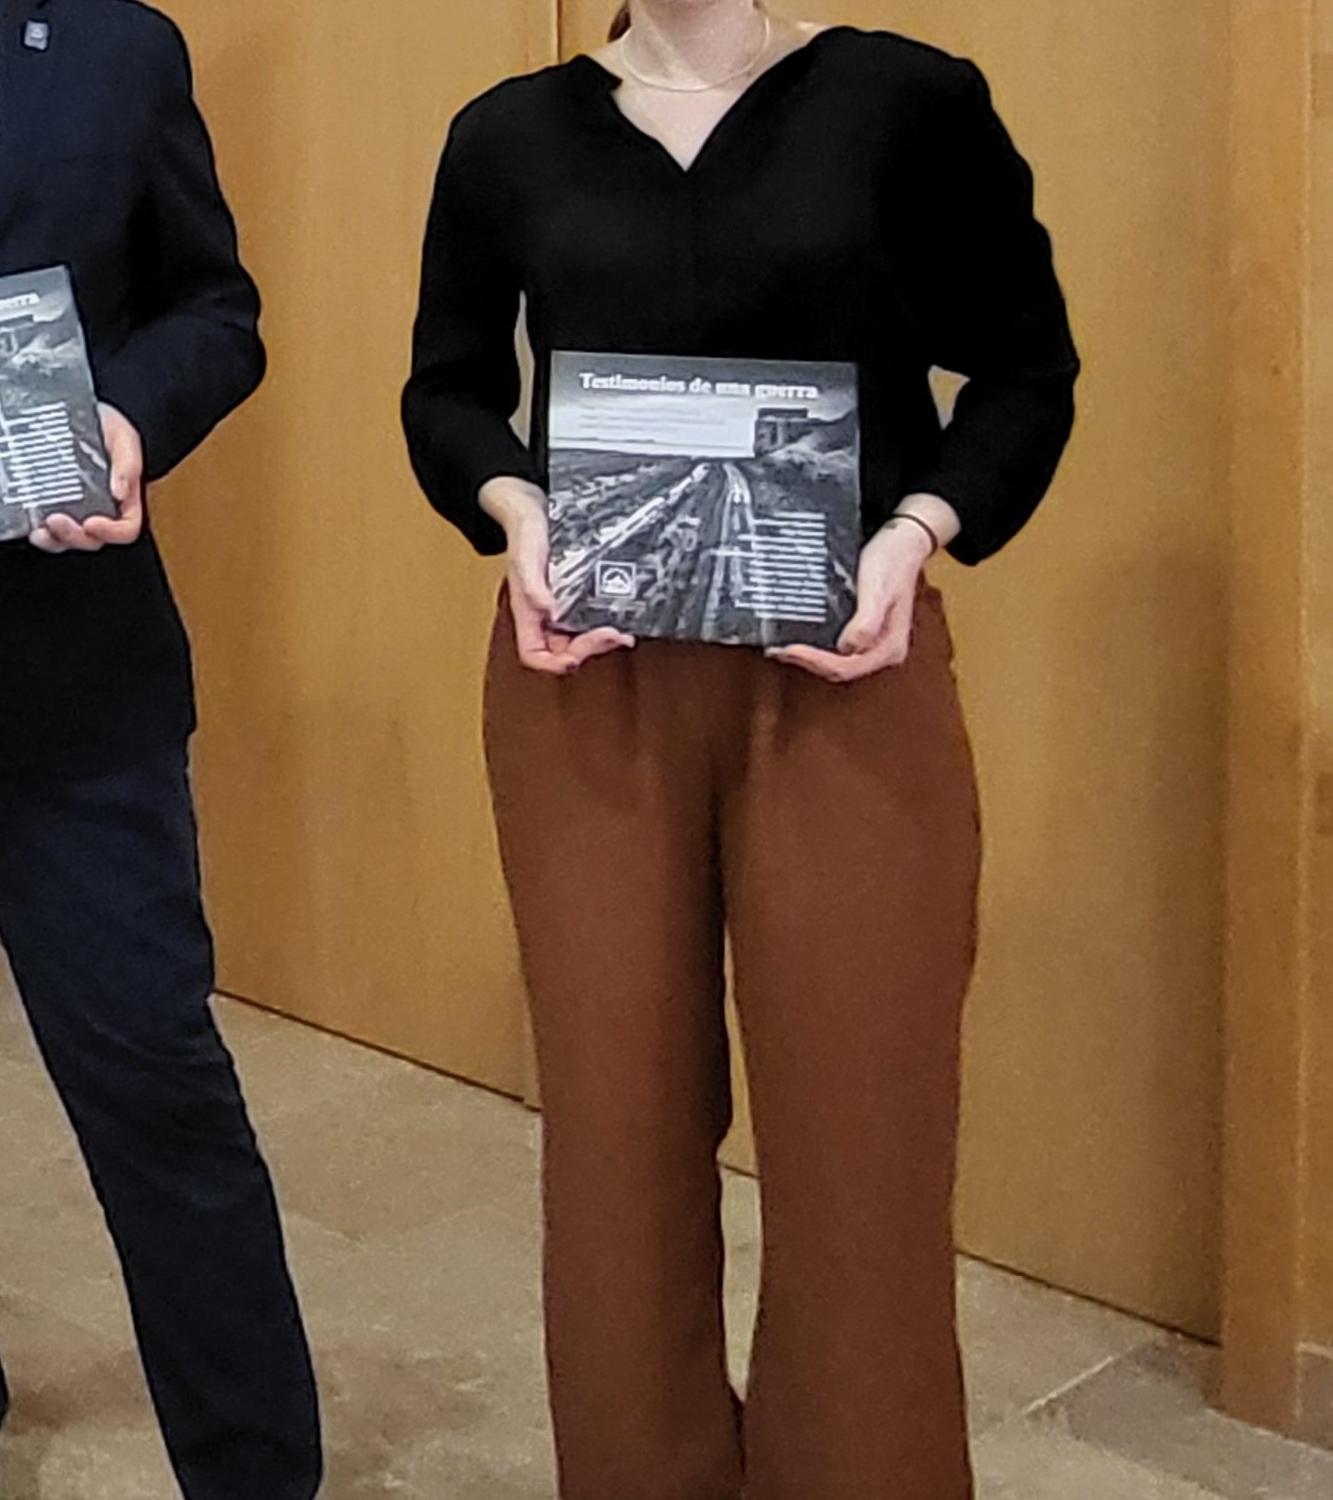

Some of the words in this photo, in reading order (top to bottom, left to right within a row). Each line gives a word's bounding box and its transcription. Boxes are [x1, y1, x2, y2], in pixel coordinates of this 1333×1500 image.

[579, 372, 684, 393] Testimonios
[689, 377, 712, 394] de
[716, 382, 750, 397] una
